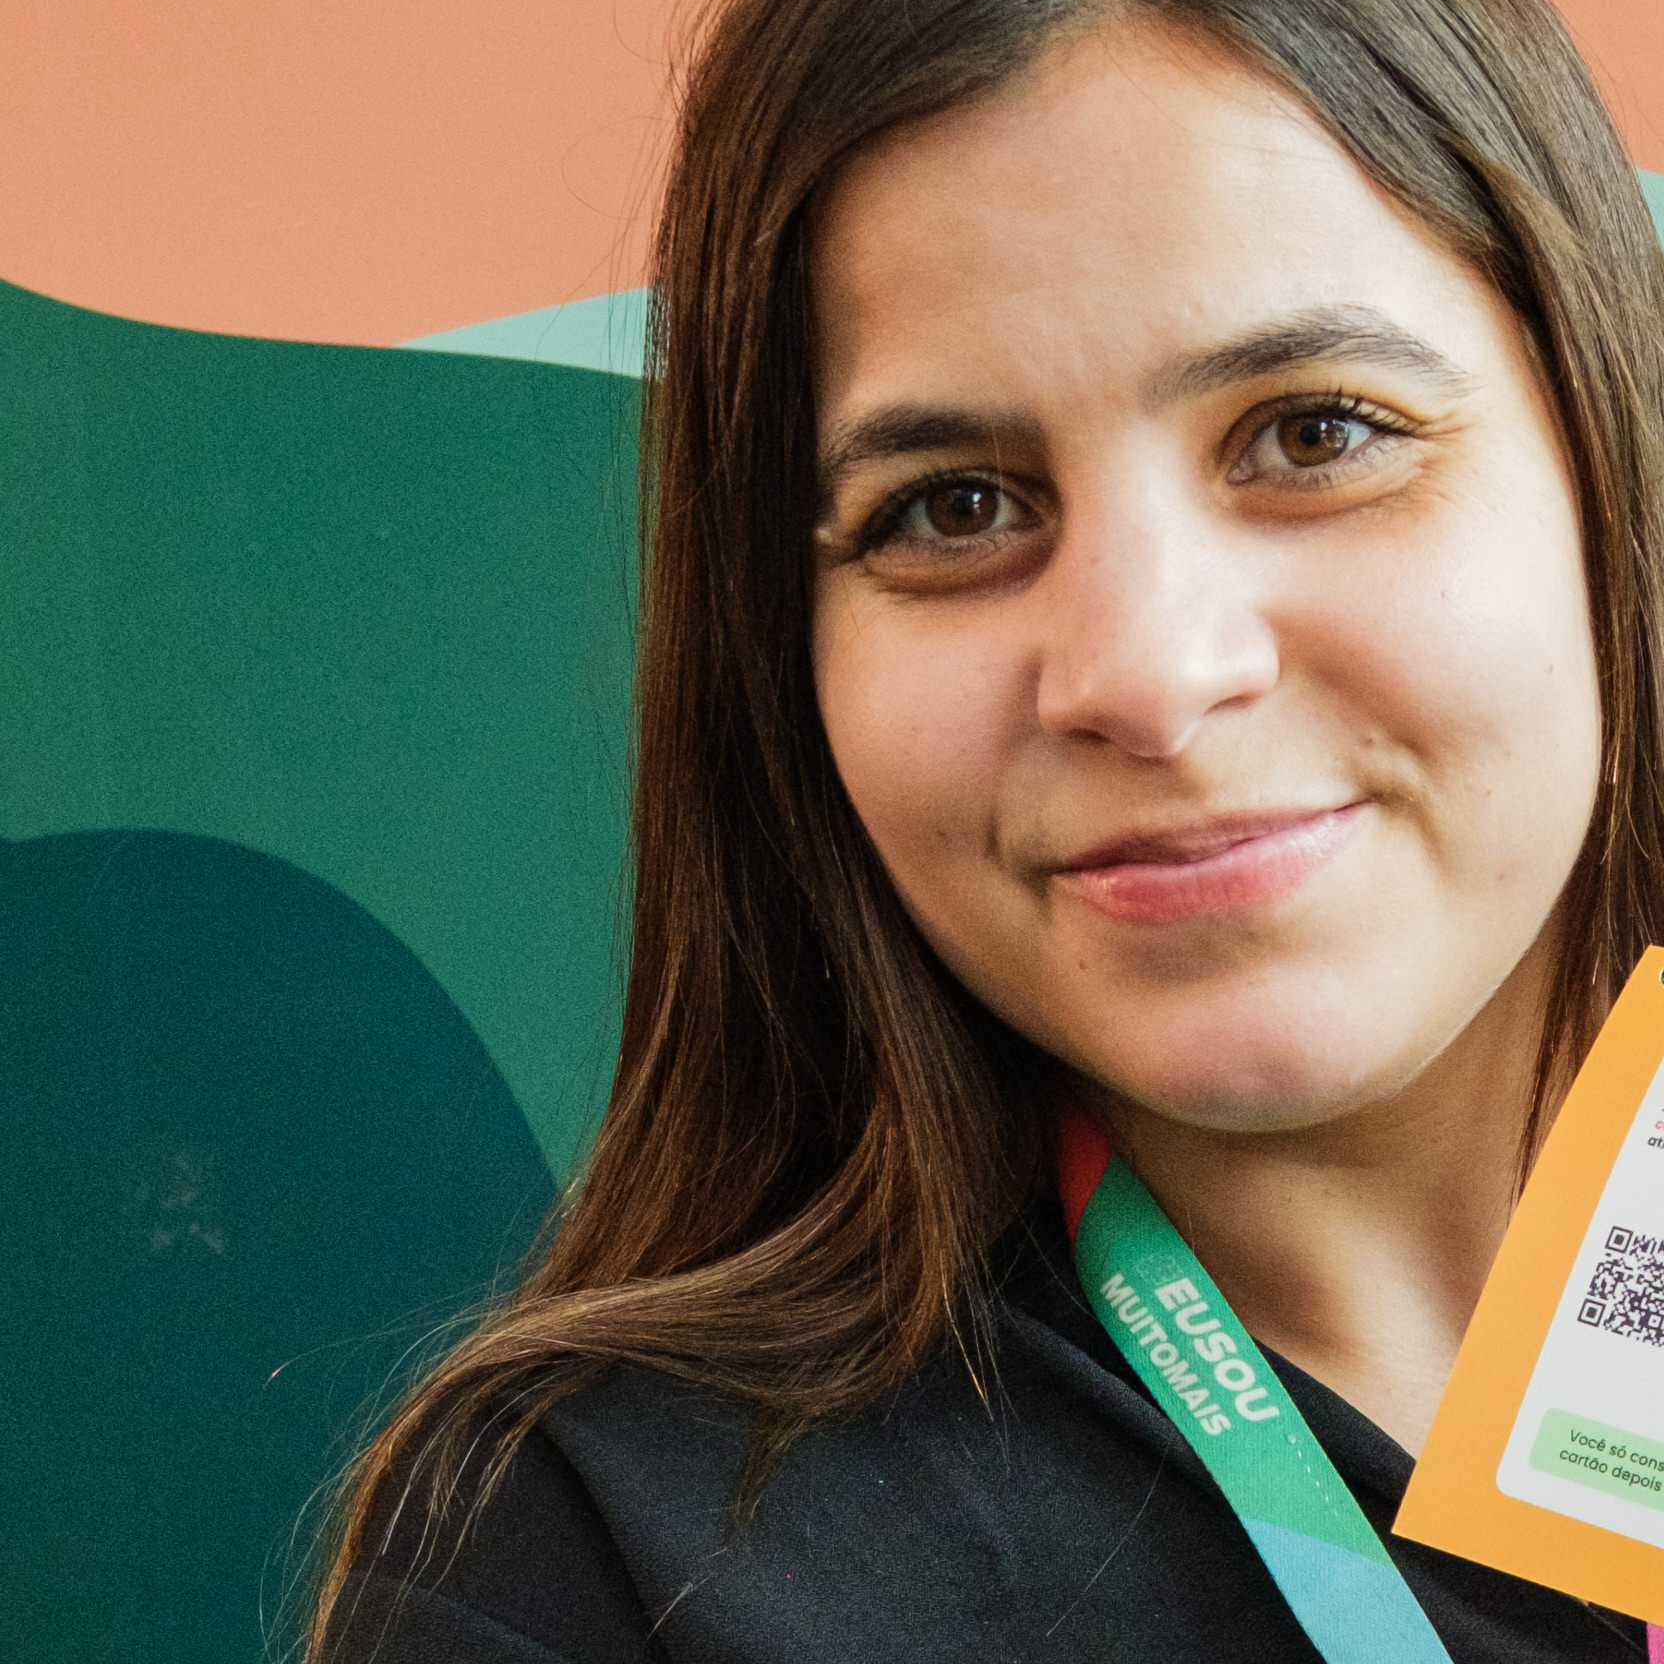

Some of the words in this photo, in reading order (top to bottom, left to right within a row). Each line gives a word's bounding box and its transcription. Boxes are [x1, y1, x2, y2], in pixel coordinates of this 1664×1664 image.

[1101, 1272, 1232, 1436] MUITOMAIS
[1571, 1430, 1606, 1451] Você
[1609, 1446, 1626, 1458] só
[1560, 1450, 1608, 1473] cartão
[1612, 1466, 1662, 1491] depois
